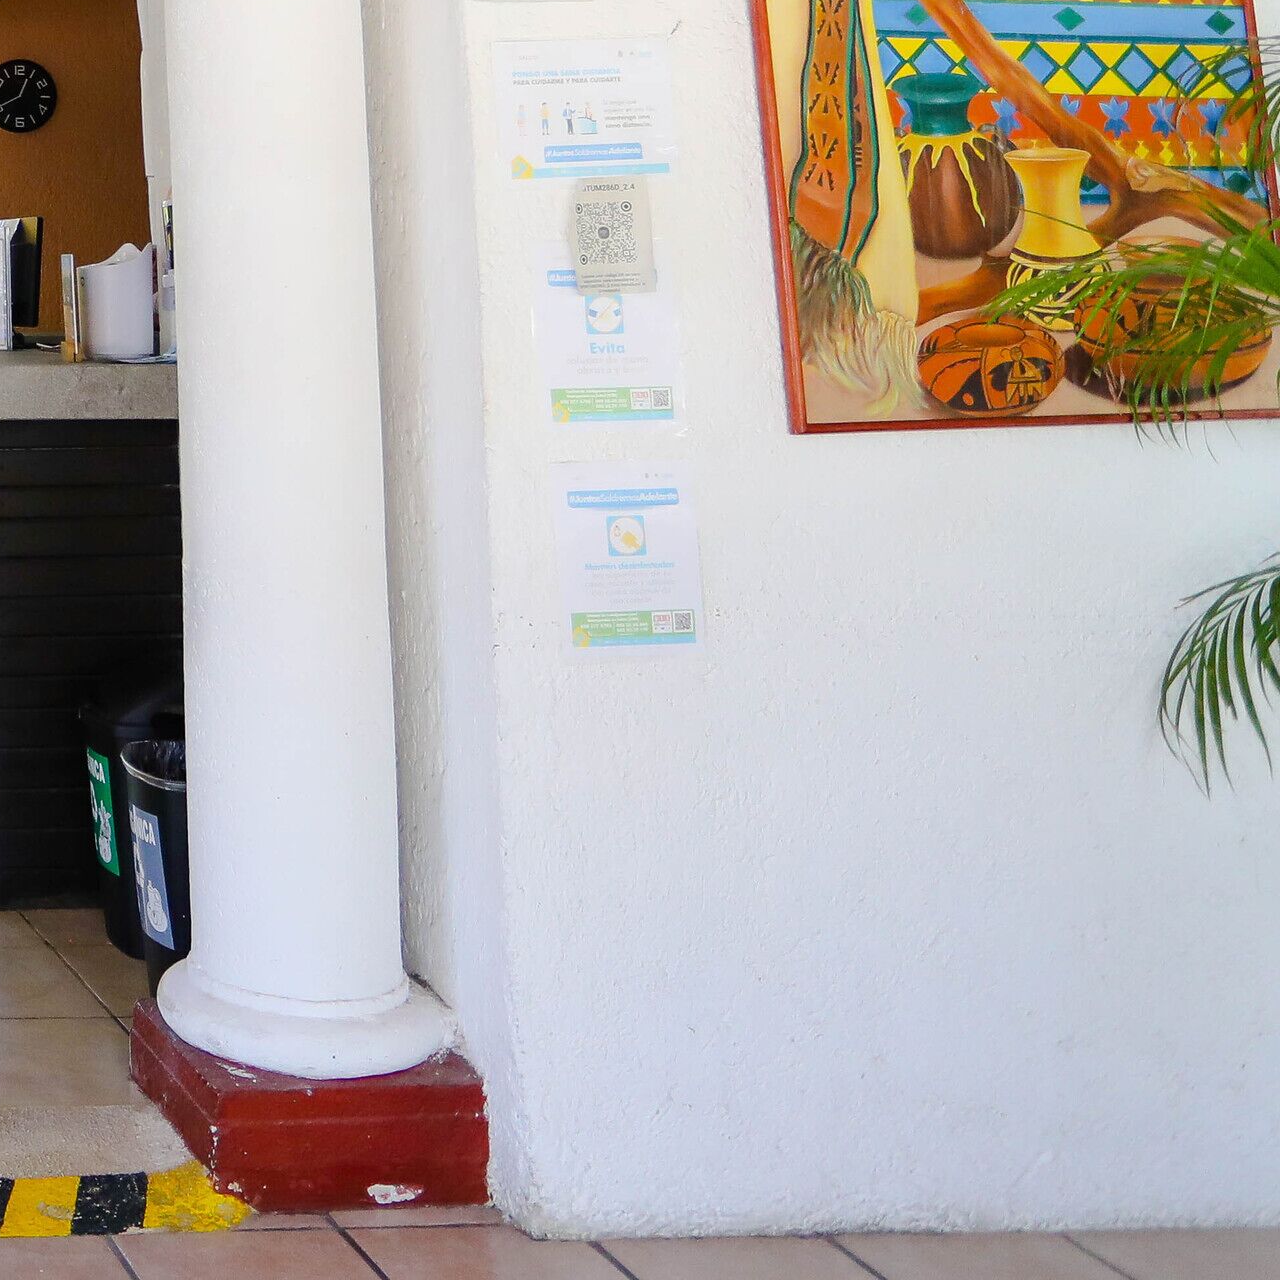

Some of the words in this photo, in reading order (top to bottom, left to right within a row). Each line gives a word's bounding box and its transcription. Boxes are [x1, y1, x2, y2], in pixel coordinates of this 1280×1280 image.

[14, 65, 26, 76] 12
[36, 78, 48, 90] 2
[38, 104, 48, 115] 4
[15, 117, 25, 128] 6
